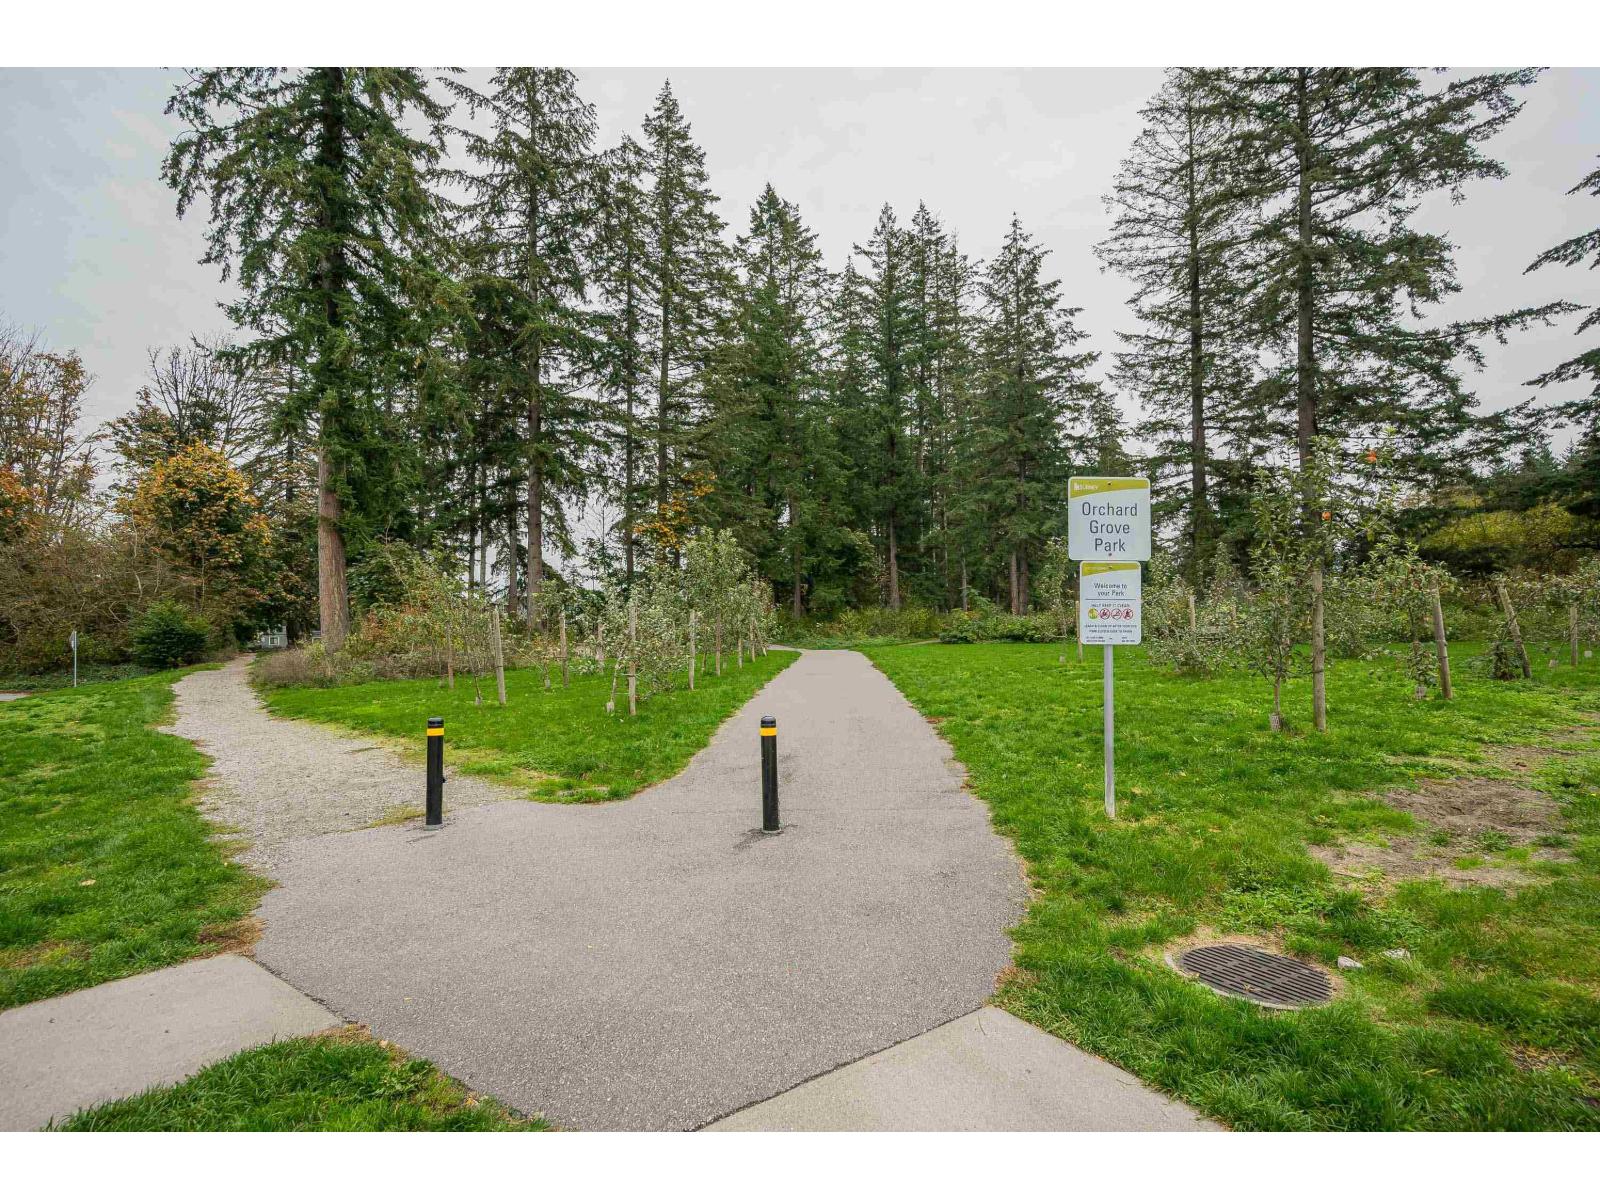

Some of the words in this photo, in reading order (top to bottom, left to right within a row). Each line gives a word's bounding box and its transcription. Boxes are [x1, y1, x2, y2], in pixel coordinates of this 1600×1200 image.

[1082, 502, 1138, 516] Orchard
[1089, 520, 1130, 534] Grove
[1095, 538, 1126, 552] Park
